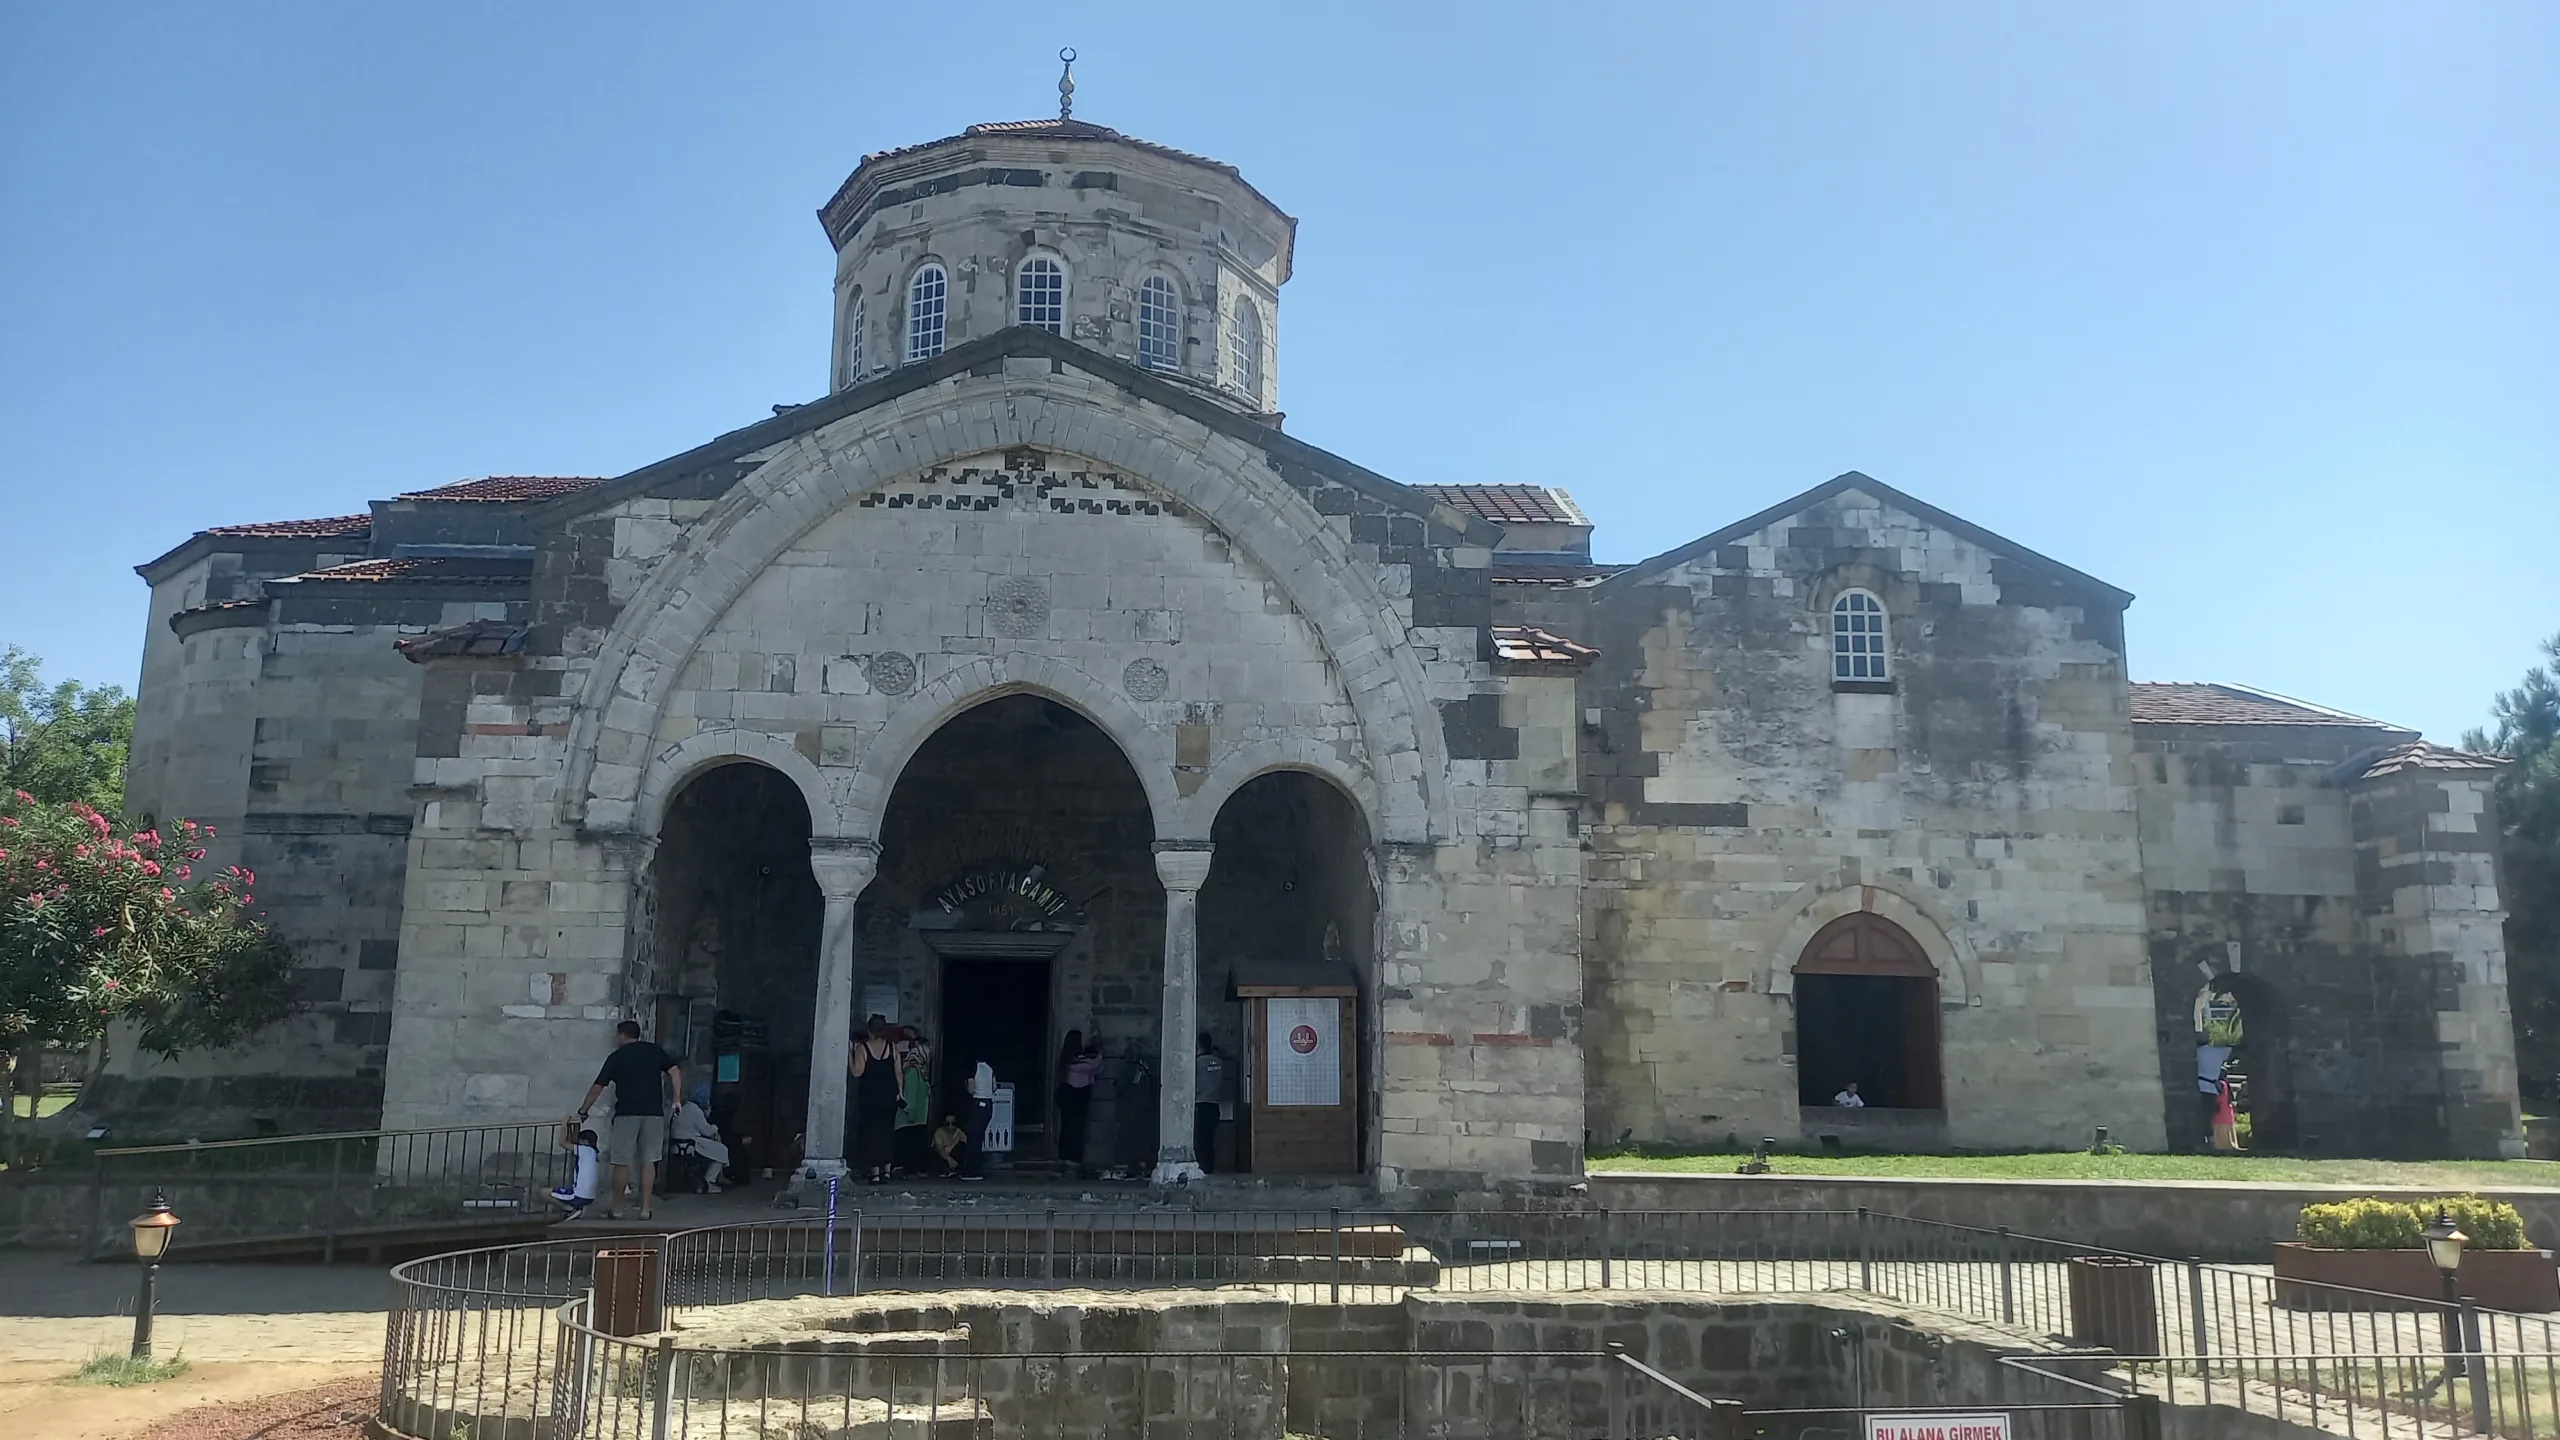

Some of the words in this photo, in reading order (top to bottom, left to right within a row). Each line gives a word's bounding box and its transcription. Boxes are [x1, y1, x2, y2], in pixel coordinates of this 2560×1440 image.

[937, 870, 1016, 914] AYASOFYA
[1019, 876, 1068, 916] CAMİİ
[1876, 1427, 1895, 1440] BU
[1900, 1427, 1945, 1440] ALANA
[1949, 1423, 2001, 1440] GİRMEK
